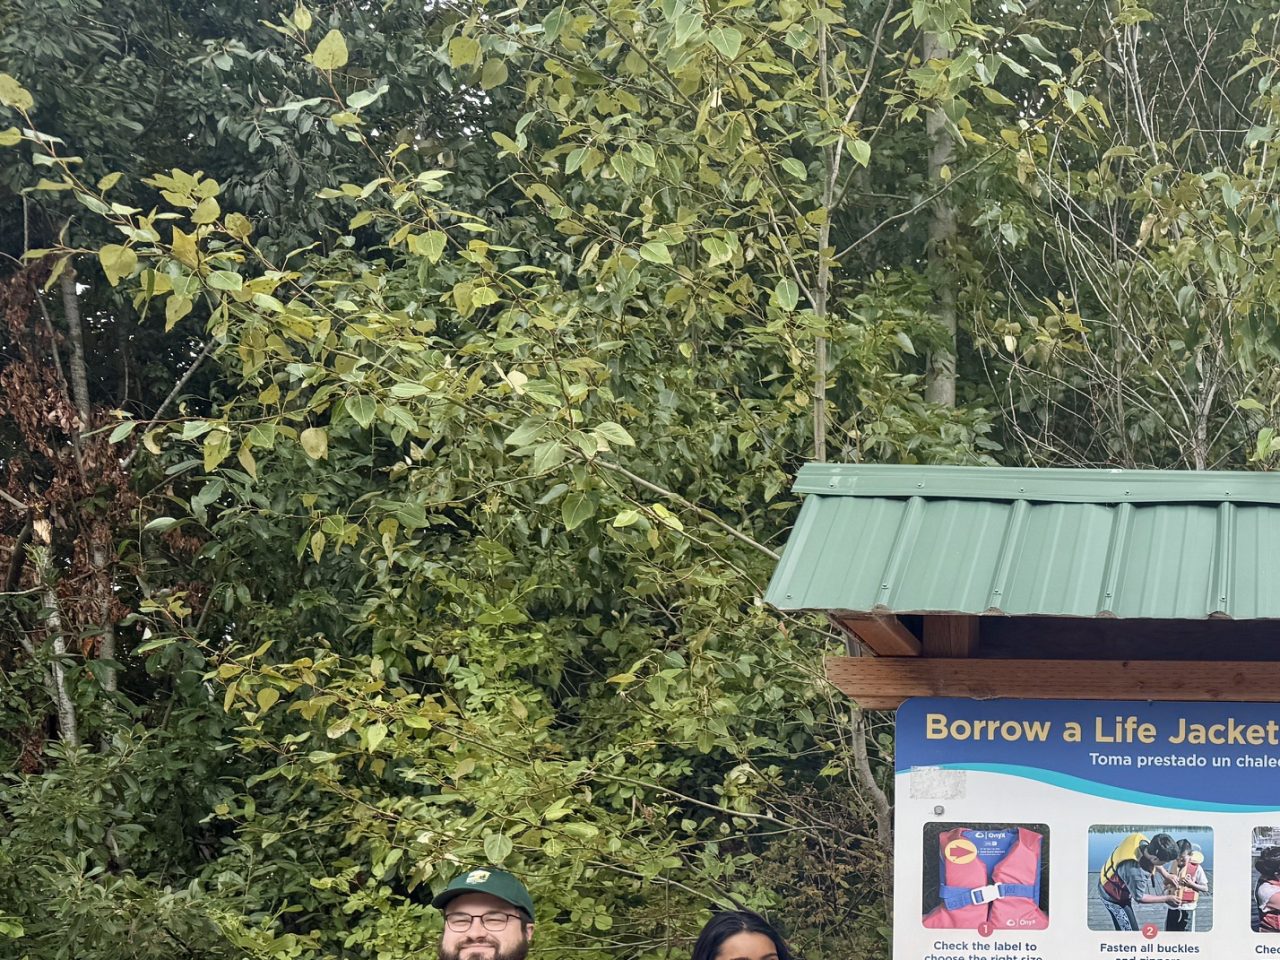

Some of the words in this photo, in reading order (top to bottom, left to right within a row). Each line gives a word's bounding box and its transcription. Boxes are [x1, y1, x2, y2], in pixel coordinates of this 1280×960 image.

[926, 714, 1051, 742] Borrow
[1062, 722, 1081, 742] a
[1095, 716, 1156, 744] Life
[1168, 718, 1279, 745] Jacket
[1089, 752, 1132, 766] Toma
[1137, 754, 1207, 768] prestado
[1212, 757, 1231, 767] un
[983, 925, 988, 934] 1
[1146, 927, 1153, 936] 2
[934, 941, 968, 950] Check
[972, 941, 990, 950] the
[994, 941, 1022, 951] label
[1025, 942, 1037, 951] to
[1100, 943, 1137, 952] Fasten
[1140, 943, 1154, 952] all
[1157, 944, 1200, 953] buckles
